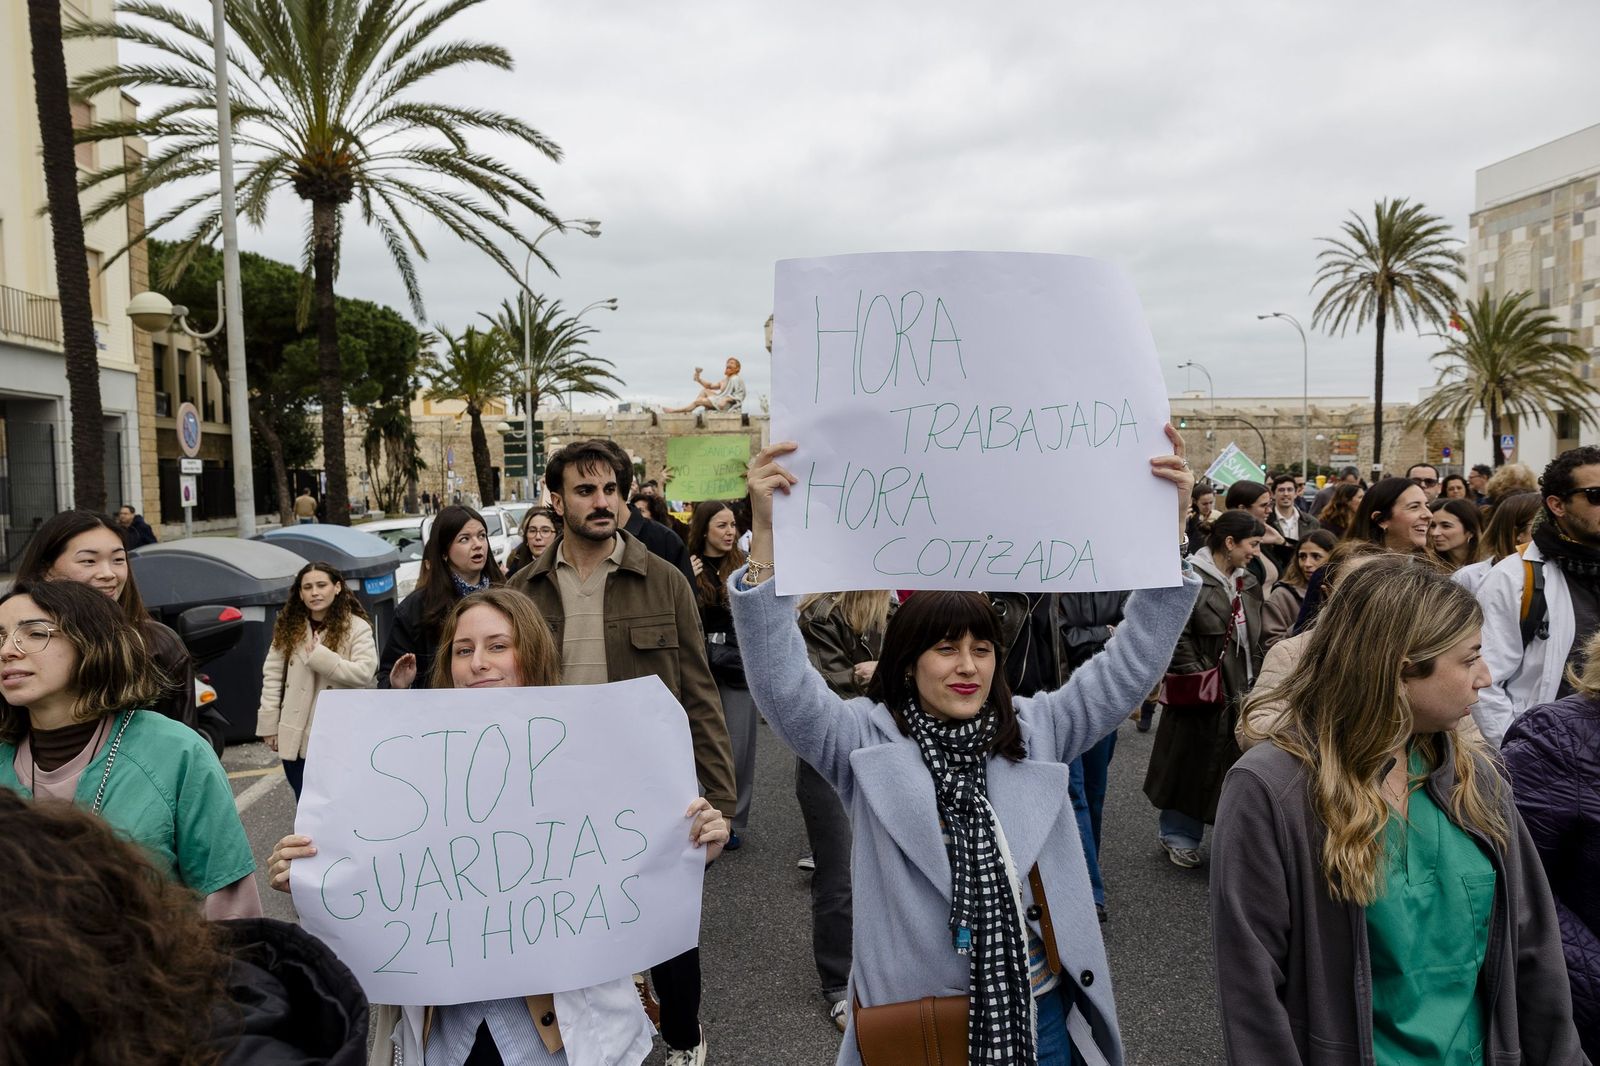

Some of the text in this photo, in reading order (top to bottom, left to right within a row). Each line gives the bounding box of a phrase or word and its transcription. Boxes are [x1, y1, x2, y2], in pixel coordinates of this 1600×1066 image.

[815, 290, 967, 404] HORA
[890, 399, 1140, 454] TRABAJADA
[805, 462, 937, 531] HORA
[353, 716, 567, 842] STOP
[321, 809, 648, 921] GUARDIAS
[373, 874, 641, 975] 24 HORAS
